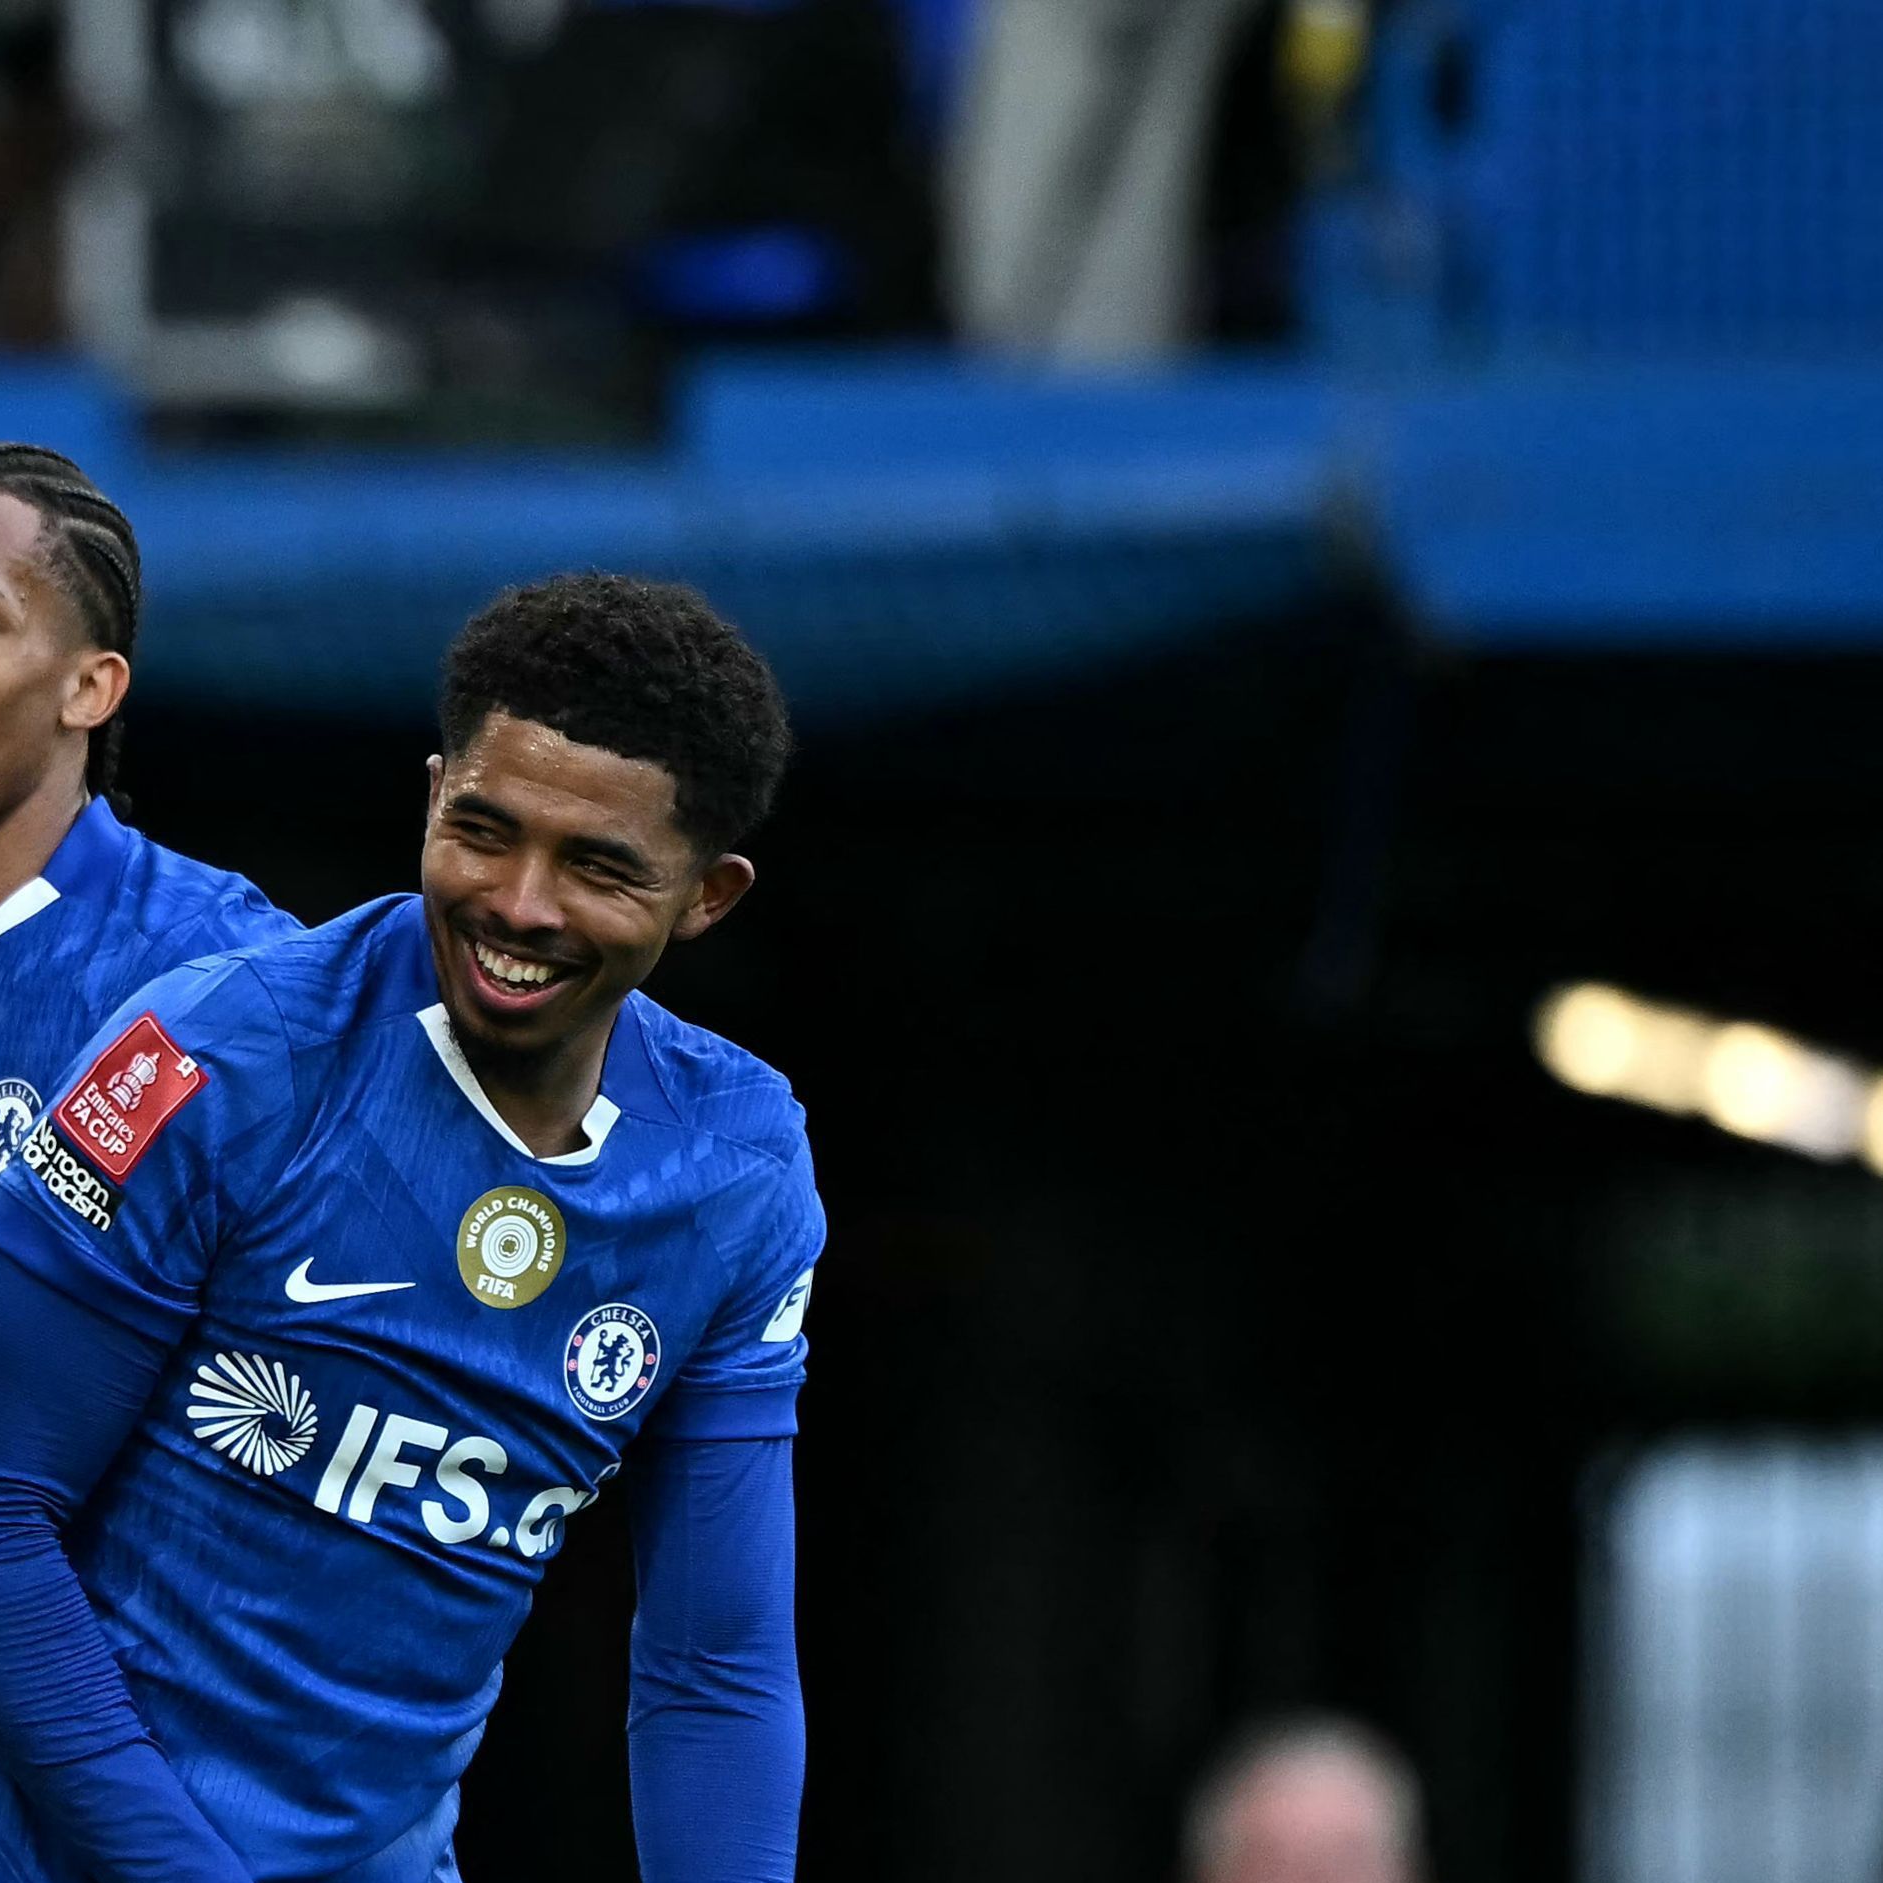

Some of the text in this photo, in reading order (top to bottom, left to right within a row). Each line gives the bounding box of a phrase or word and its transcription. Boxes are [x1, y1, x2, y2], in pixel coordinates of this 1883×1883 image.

[70, 1097, 127, 1155] FA CUP
[83, 1082, 135, 1142] Emirates
[21, 1131, 112, 1232] for racism
[34, 1116, 110, 1207] No room
[466, 1197, 556, 1273] WORLD CHAMPIONS
[476, 1274, 516, 1300] FIFA
[590, 1308, 651, 1341] CHELSEA
